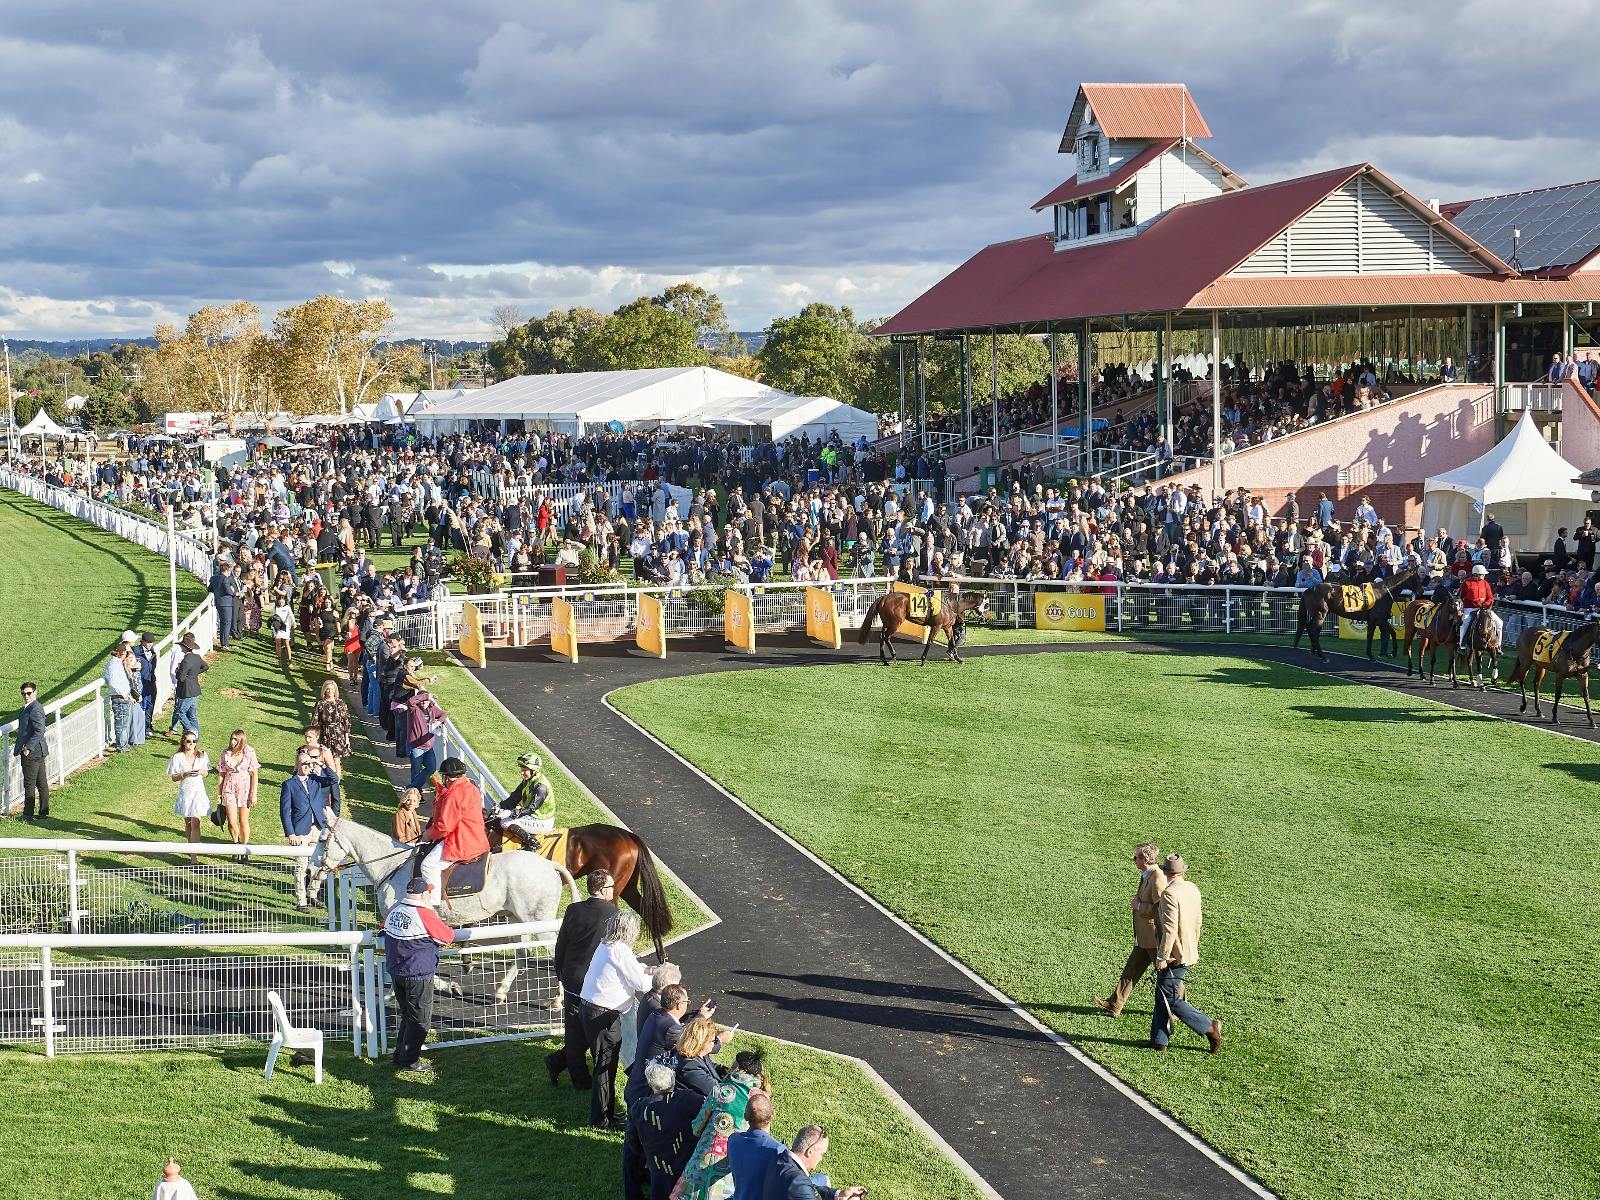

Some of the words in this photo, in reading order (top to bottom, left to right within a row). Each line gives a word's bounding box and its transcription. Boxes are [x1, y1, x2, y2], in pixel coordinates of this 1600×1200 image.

[912, 596, 926, 612] 14
[1045, 608, 1065, 616] XXXX
[1067, 606, 1097, 619] GOLD
[1415, 606, 1426, 623] 8
[1535, 636, 1548, 655] 5
